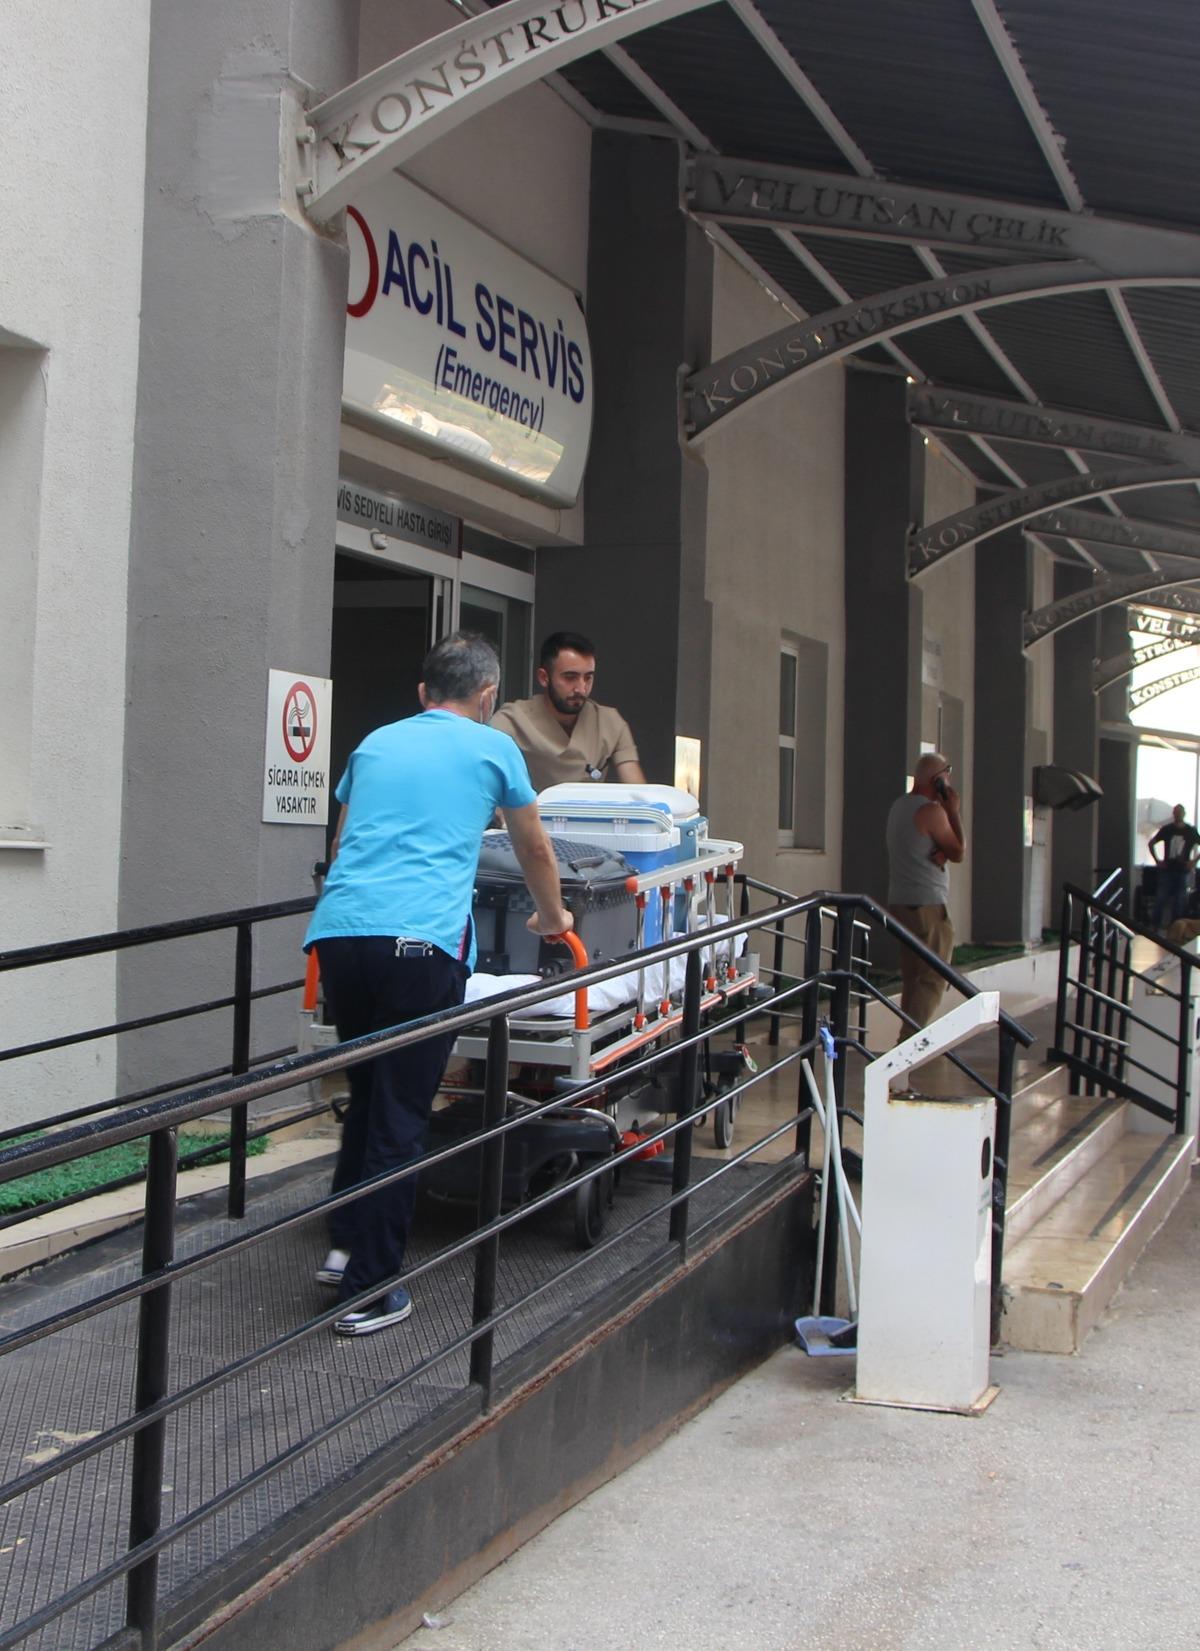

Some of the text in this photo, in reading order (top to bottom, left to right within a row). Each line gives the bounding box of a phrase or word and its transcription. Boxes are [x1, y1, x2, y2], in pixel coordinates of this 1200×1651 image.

[713, 170, 955, 232] VELUTSAN
[382, 229, 585, 404] ACİL SERVİS
[433, 344, 545, 441] (Emergency)
[354, 494, 394, 526] SEDYELİ
[397, 508, 426, 536] HASTA
[268, 764, 326, 791] SİGARA İÇMEK
[276, 796, 317, 815] YASAKTIR
